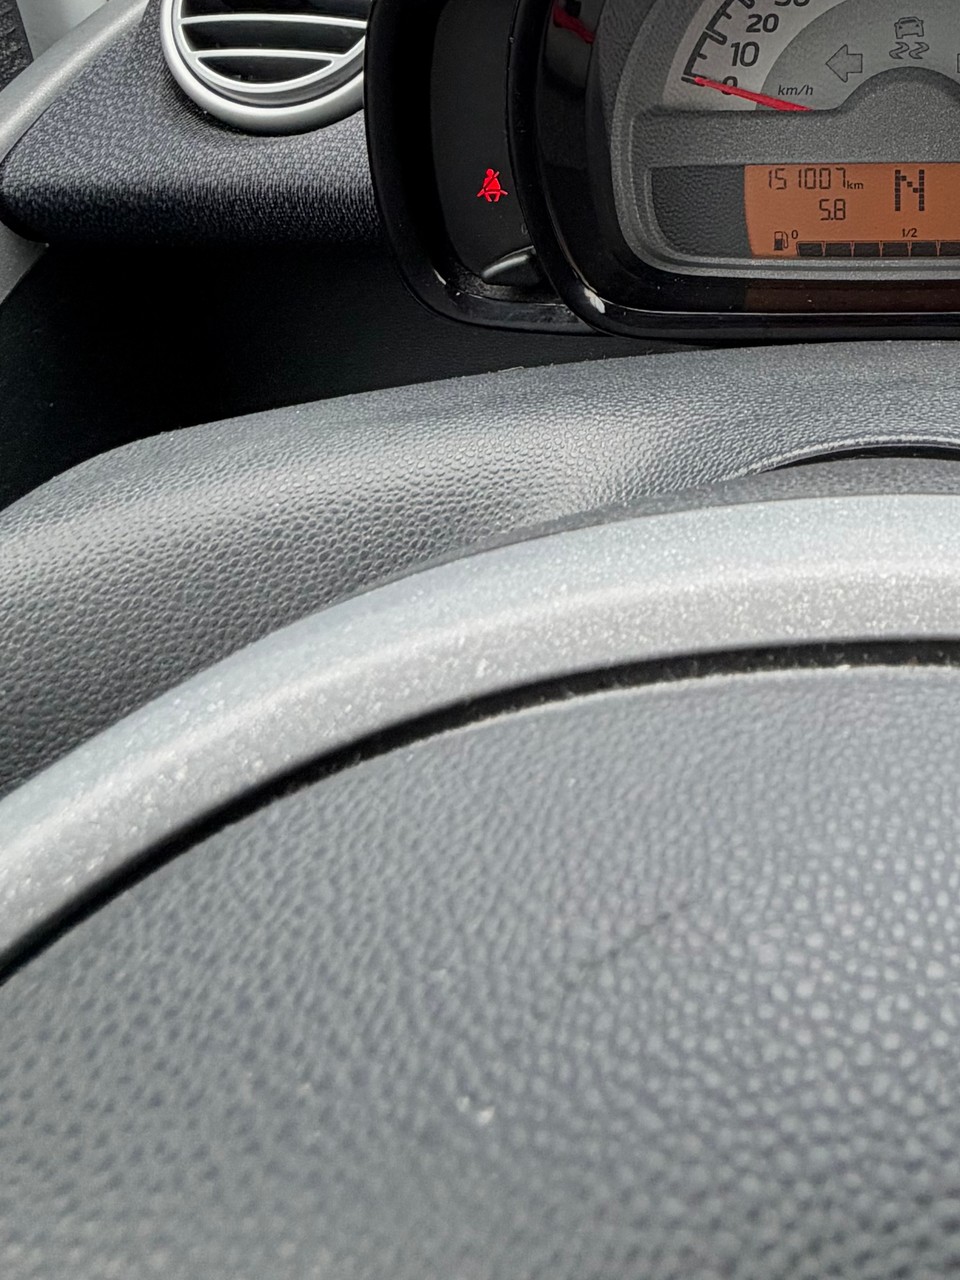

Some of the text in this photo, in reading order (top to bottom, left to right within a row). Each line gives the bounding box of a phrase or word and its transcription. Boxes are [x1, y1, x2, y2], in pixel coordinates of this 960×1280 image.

[745, 13, 779, 33] 20
[730, 41, 760, 67] 10
[777, 84, 814, 96] km/h
[895, 169, 925, 211] N
[819, 198, 846, 221] 5.8
[791, 229, 799, 240] 0
[902, 227, 918, 238] 1/2
